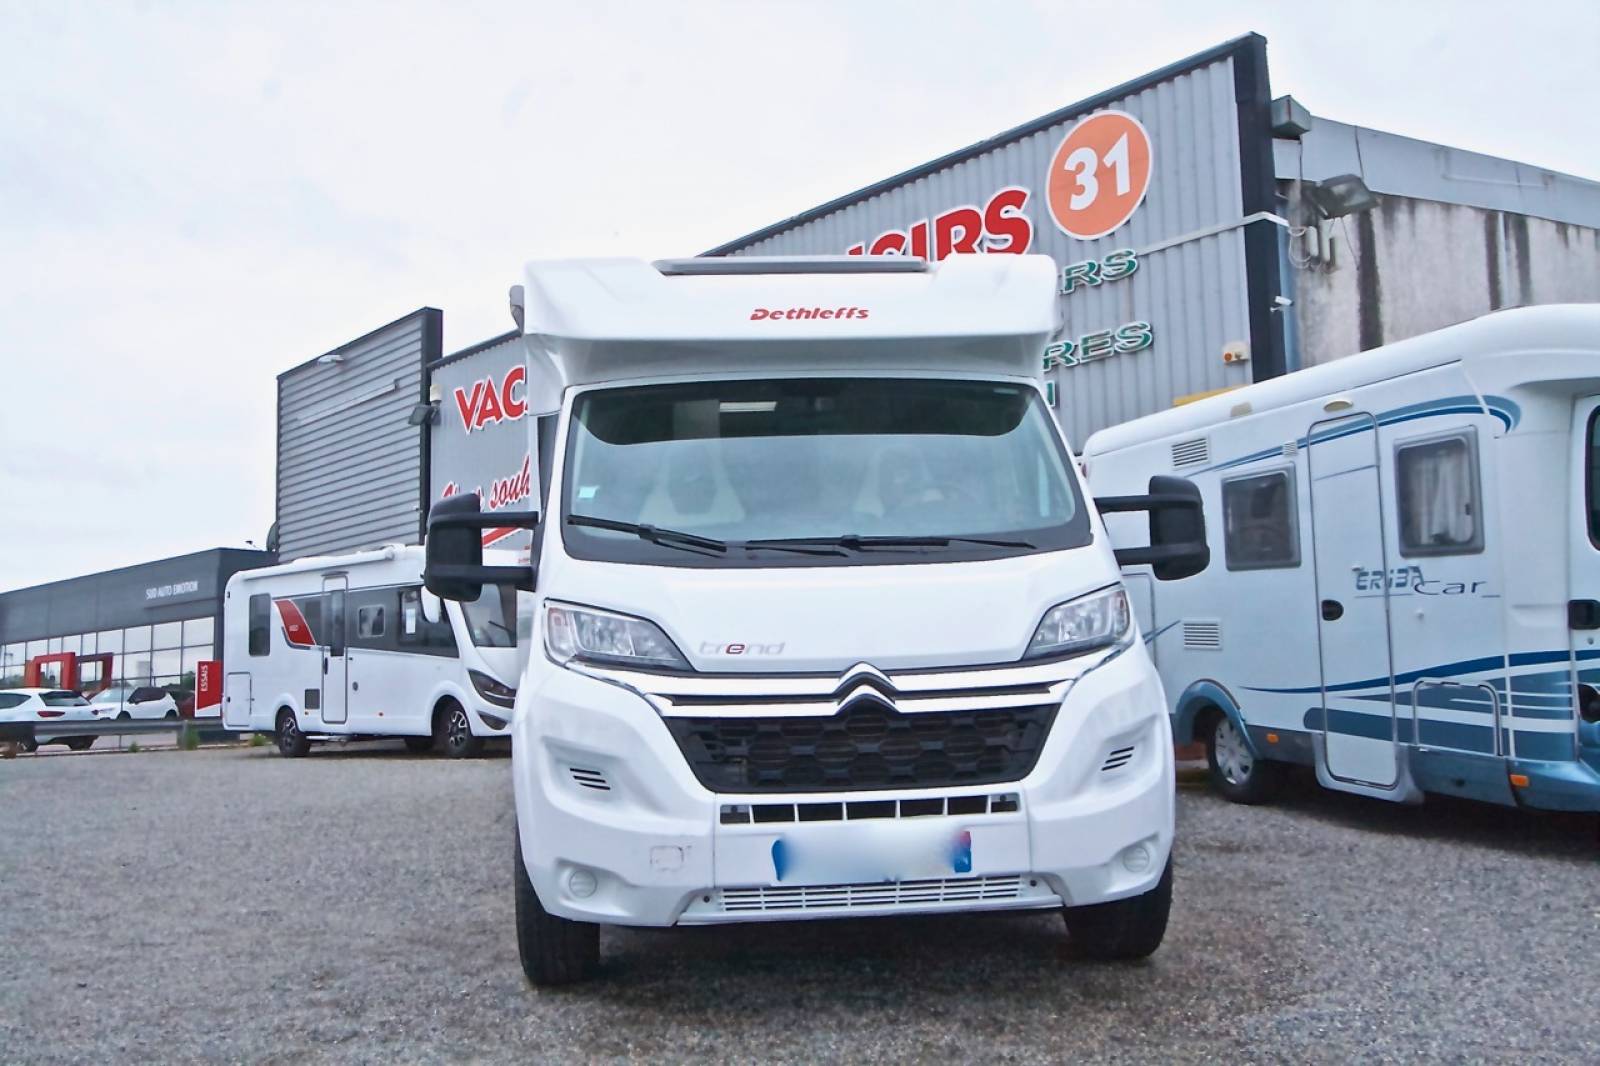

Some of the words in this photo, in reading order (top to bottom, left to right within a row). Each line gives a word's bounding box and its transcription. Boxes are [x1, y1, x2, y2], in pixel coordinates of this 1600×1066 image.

[1063, 132, 1131, 211] 31
[750, 306, 869, 321] Dethleffs
[1042, 321, 1153, 372] RES
[1413, 580, 1487, 595] Car
[700, 641, 786, 655] trend
